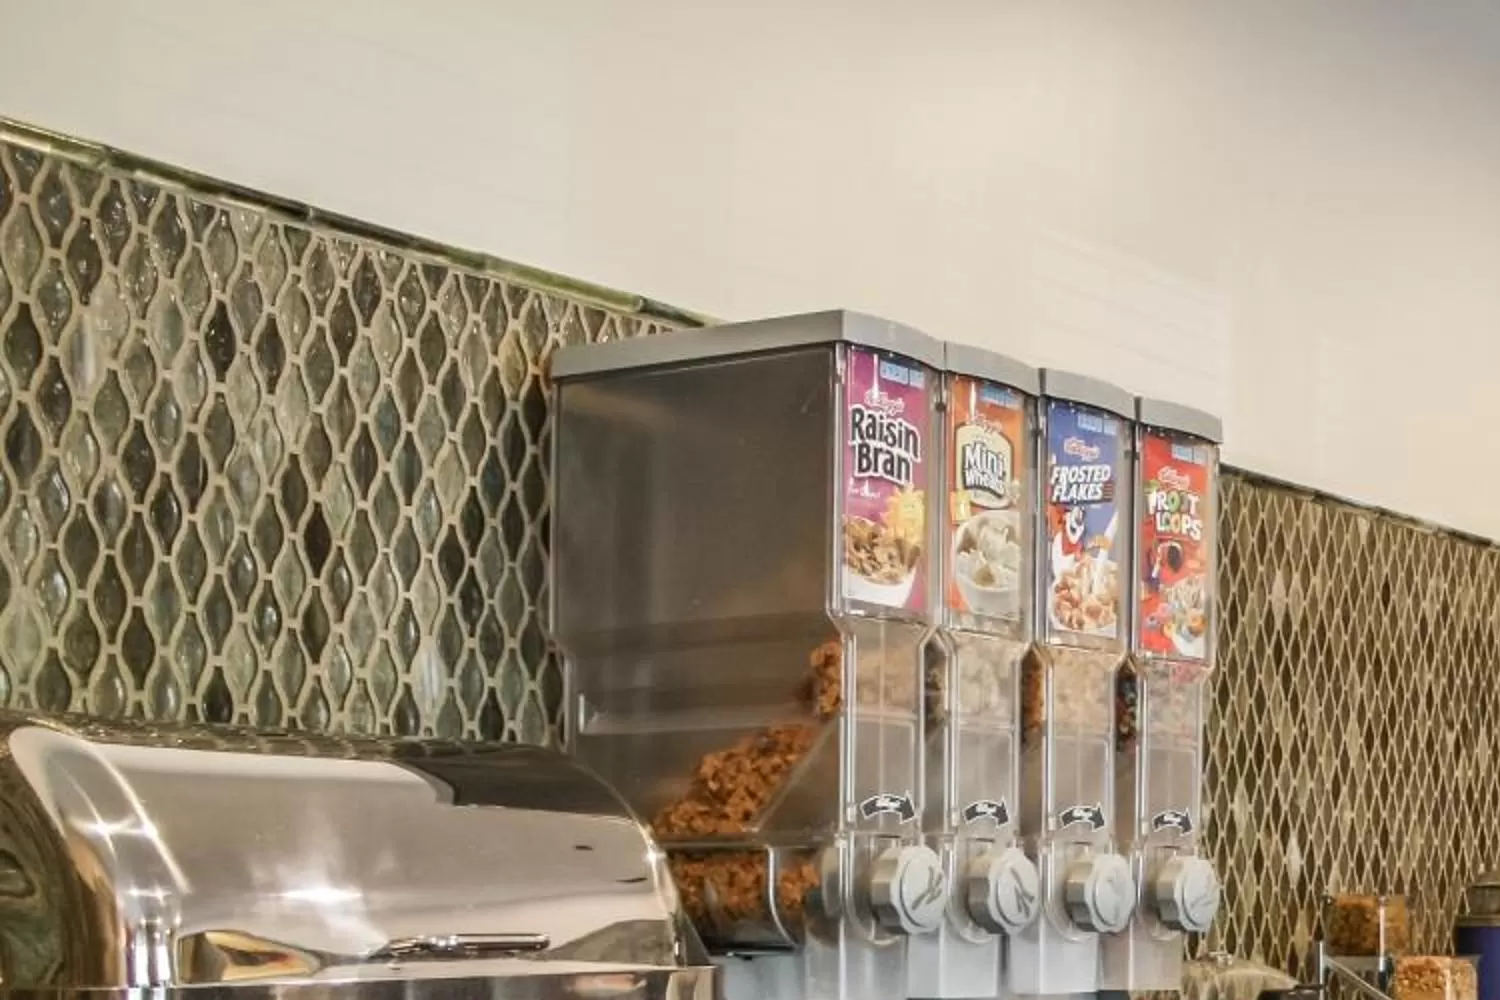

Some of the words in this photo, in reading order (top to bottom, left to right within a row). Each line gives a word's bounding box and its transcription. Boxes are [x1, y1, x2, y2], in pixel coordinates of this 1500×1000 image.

[851, 407, 920, 460] Raisin
[857, 443, 911, 482] Bran
[1051, 464, 1111, 484] FROSTED
[1052, 482, 1104, 502] FLAKES
